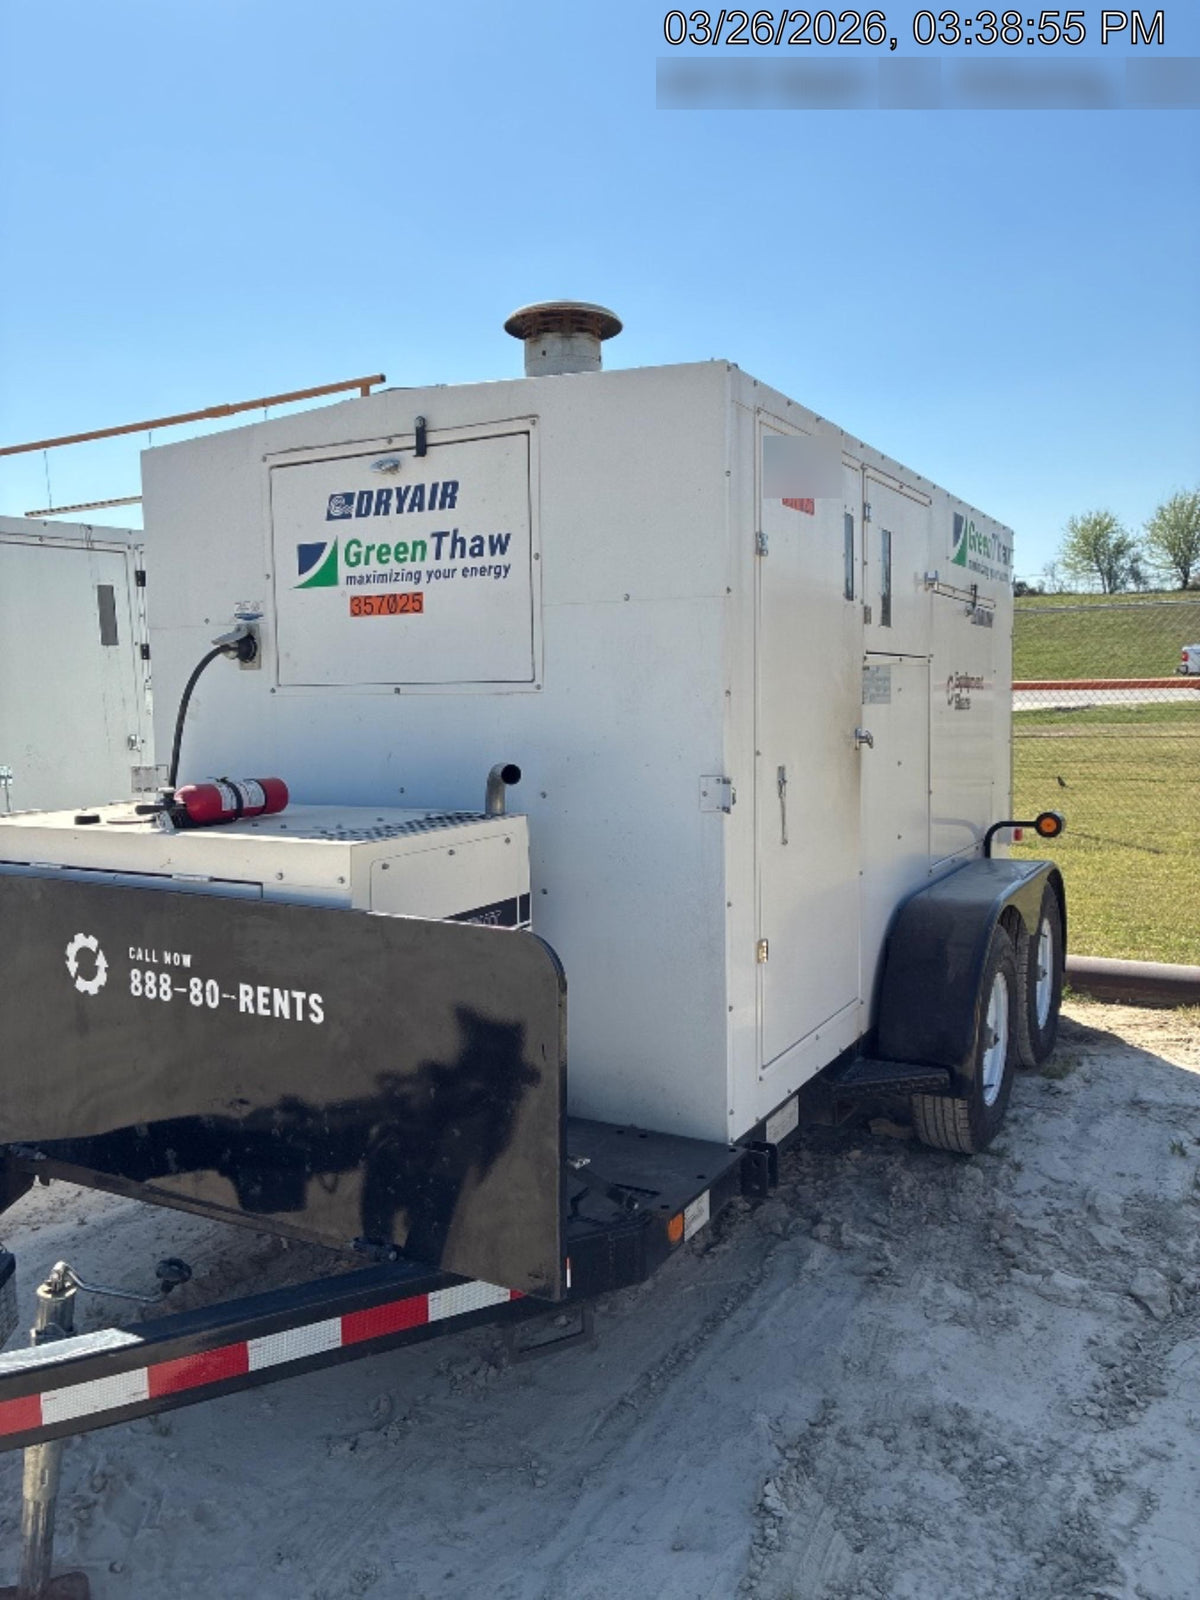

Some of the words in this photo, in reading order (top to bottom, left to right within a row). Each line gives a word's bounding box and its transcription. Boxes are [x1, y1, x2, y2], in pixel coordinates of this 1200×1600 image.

[355, 480, 459, 518] DRYAIR
[344, 528, 512, 567] GreenThaw
[346, 569, 422, 585] maximizing
[426, 567, 457, 584] your
[462, 563, 511, 579] energy
[351, 593, 423, 616] 357025
[129, 947, 158, 963] CALL
[164, 951, 192, 968] NOW
[130, 968, 324, 1024] 888-80-RENTS
